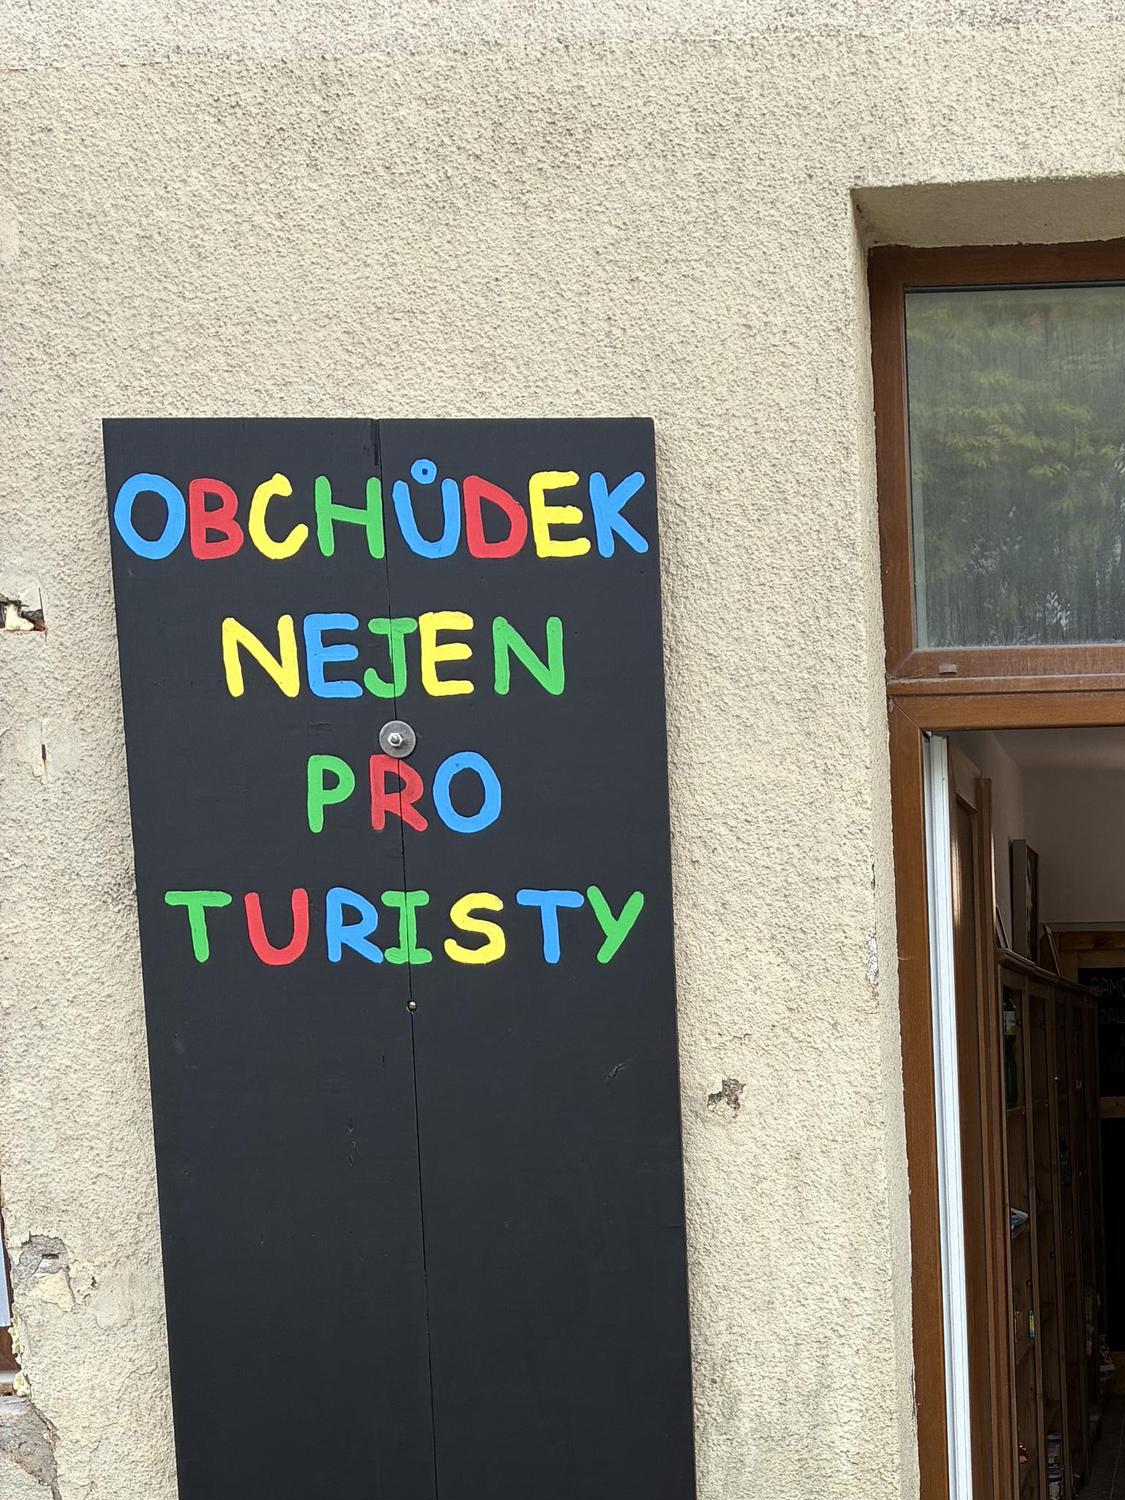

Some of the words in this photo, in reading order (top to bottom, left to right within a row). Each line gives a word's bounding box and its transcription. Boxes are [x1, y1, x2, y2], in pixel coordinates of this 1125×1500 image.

[113, 458, 649, 561] OBCHŮDEK
[222, 611, 566, 698] NEJEN
[307, 751, 503, 834] PRO
[165, 885, 644, 967] TURISTY
